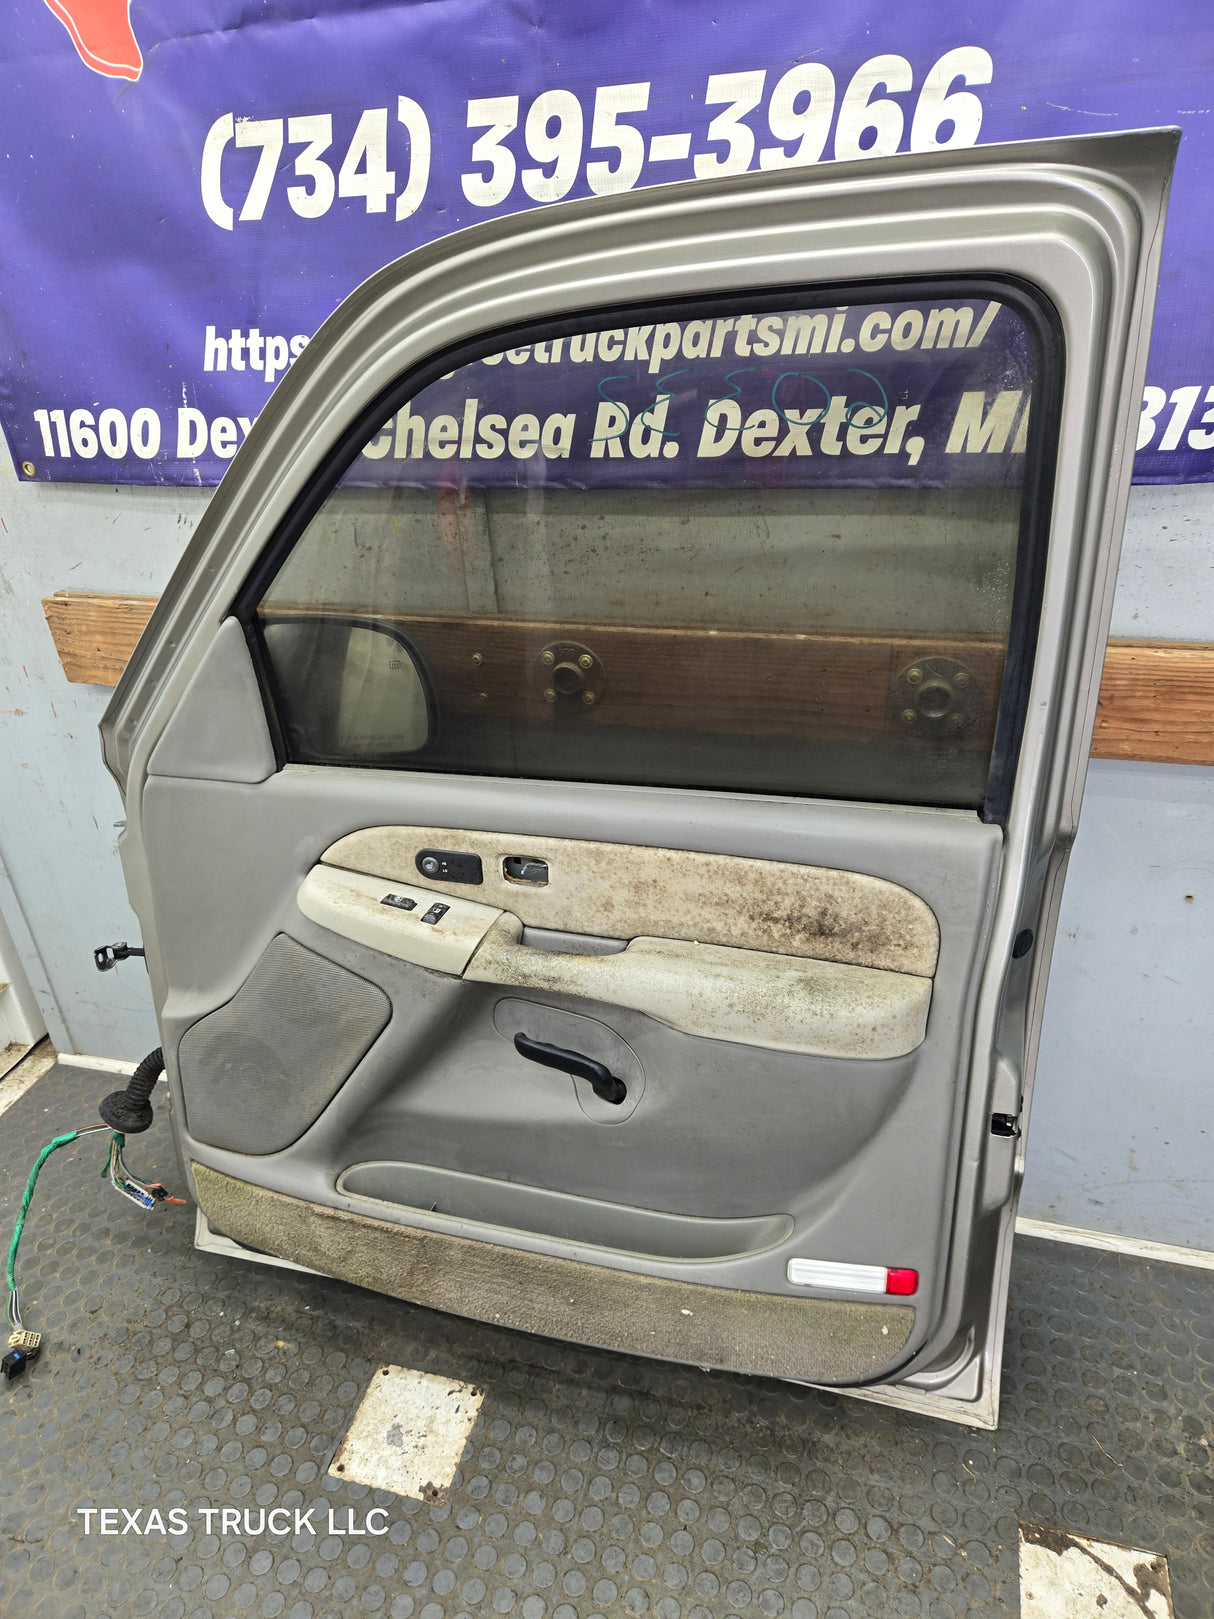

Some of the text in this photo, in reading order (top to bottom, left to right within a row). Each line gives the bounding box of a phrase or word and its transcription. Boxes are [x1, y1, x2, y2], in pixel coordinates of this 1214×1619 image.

[200, 45, 994, 231] (734) 395-3966
[34, 406, 161, 459] 11600
[589, 394, 679, 459] Rd.
[697, 395, 926, 466] Dexter,
